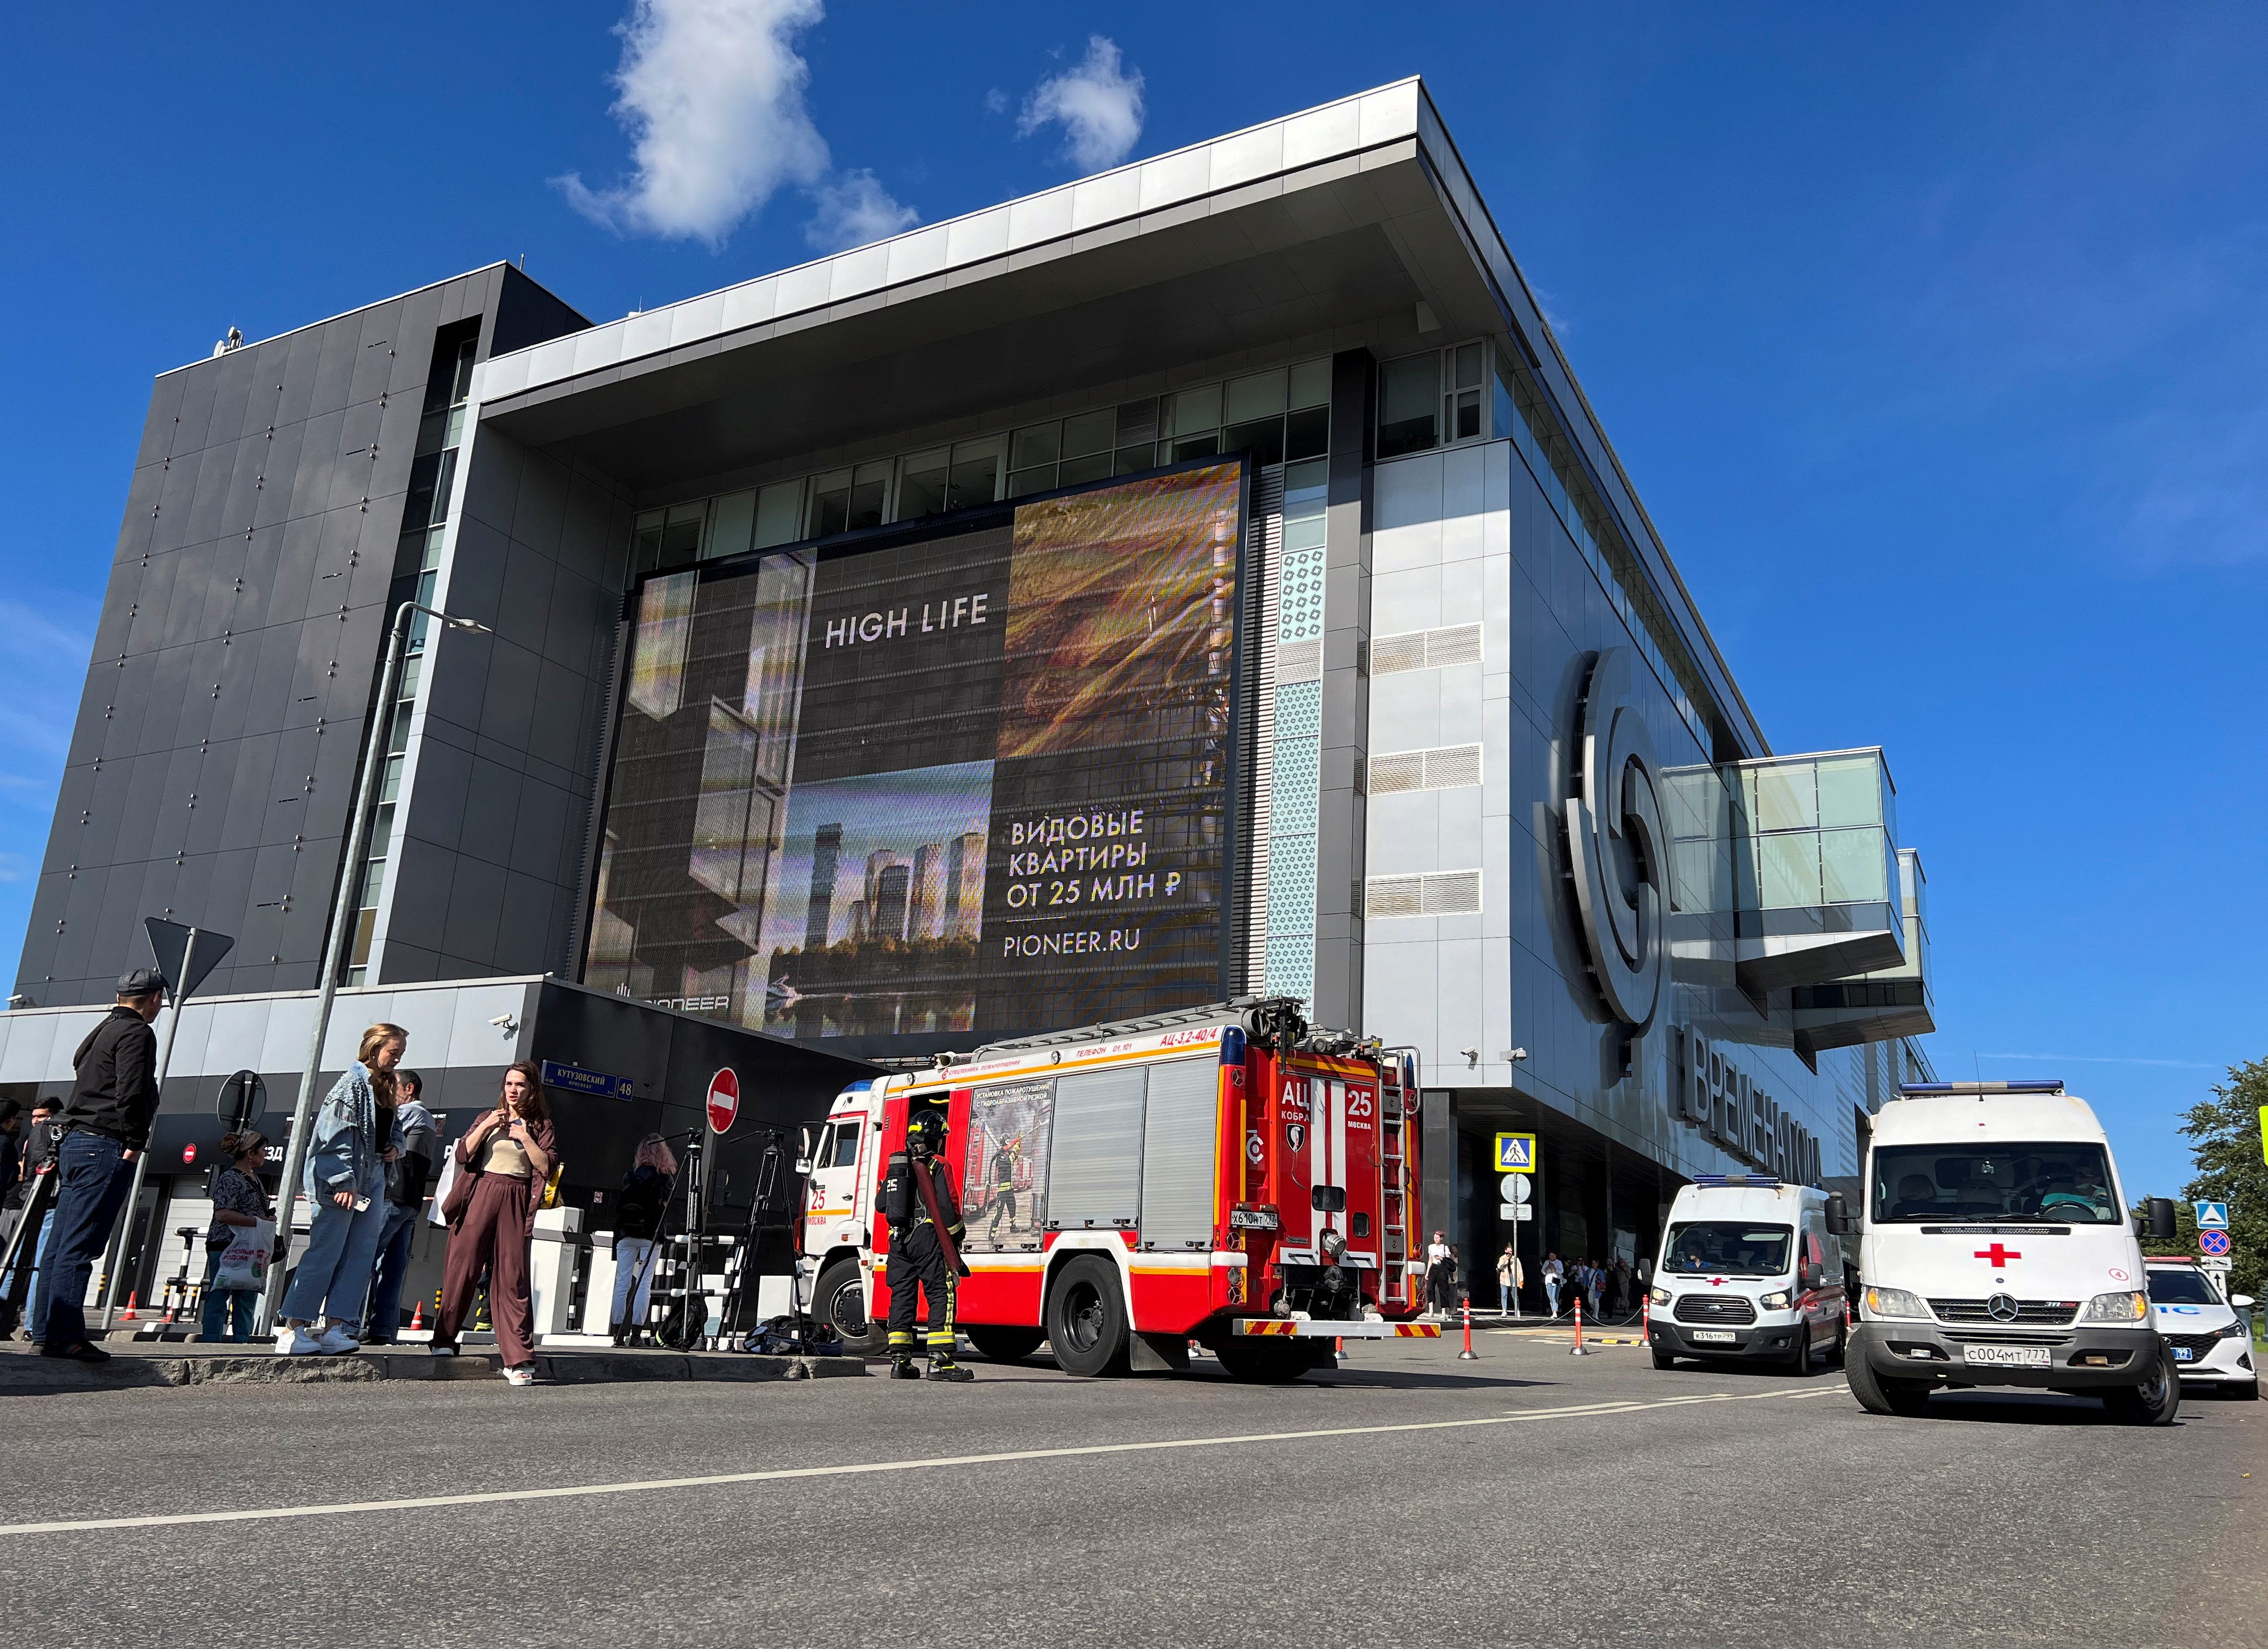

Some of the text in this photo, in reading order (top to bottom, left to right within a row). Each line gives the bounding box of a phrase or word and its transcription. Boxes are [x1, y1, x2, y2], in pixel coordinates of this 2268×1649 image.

[826, 593, 988, 648] HIGH LIFE
[1011, 810, 1144, 847] ВИДОВЫЕ
[1009, 842, 1146, 877] КВАРТИРЫ
[1007, 882, 1041, 908] ОТ
[1048, 880, 1080, 905] 25
[1090, 873, 1154, 902] МЛН
[1003, 928, 1140, 957] PIONEER.RU
[1076, 1047, 1106, 1058] ТЕЛЕФОН
[1160, 1027, 1218, 1047] АЦ-3,2-40/4
[949, 1060, 1021, 1075] СПЕЦТЕХНИКА ПОЖАРОТУШЕНИЯ
[558, 1068, 605, 1086] КУТУЗОВСКИЙ
[568, 1081, 592, 1089] ПРОСПЕКТ
[620, 1083, 631, 1096] 48
[1005, 1083, 1049, 1096] ПОЖАРОТУШЕНИЯ
[1281, 1081, 1309, 1111] АЦ
[981, 1096, 1027, 1107] ГИДРОАБРАЗИВНОЙ
[1028, 1092, 1048, 1101] РЕЗКОЙ
[1348, 1090, 1372, 1116] 25
[1281, 1110, 1310, 1122] КОБРА
[1348, 1120, 1371, 1130] МОСКВА
[811, 1190, 826, 1209] 25
[807, 1216, 826, 1225] МОСКВА
[1265, 1213, 1275, 1222] 777
[1968, 1348, 2046, 1362] С004МТ 777
